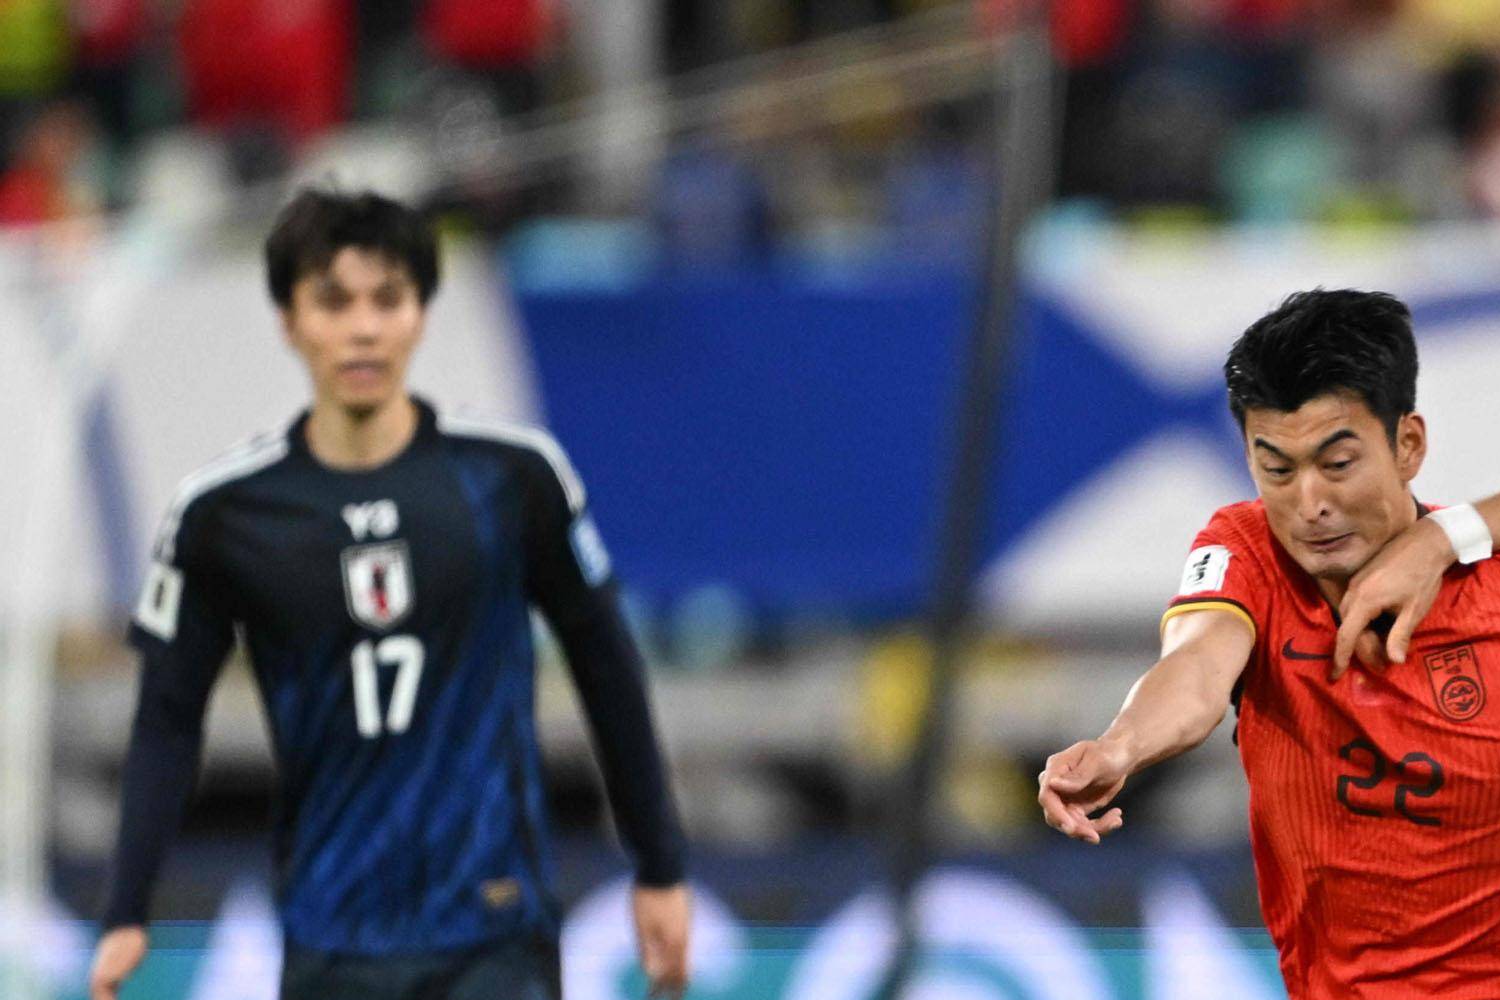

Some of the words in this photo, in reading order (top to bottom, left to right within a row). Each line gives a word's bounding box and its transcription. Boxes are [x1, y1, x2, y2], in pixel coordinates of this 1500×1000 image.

[351, 634, 426, 740] 17
[1428, 647, 1472, 672] CFA
[1336, 738, 1445, 827] 22
